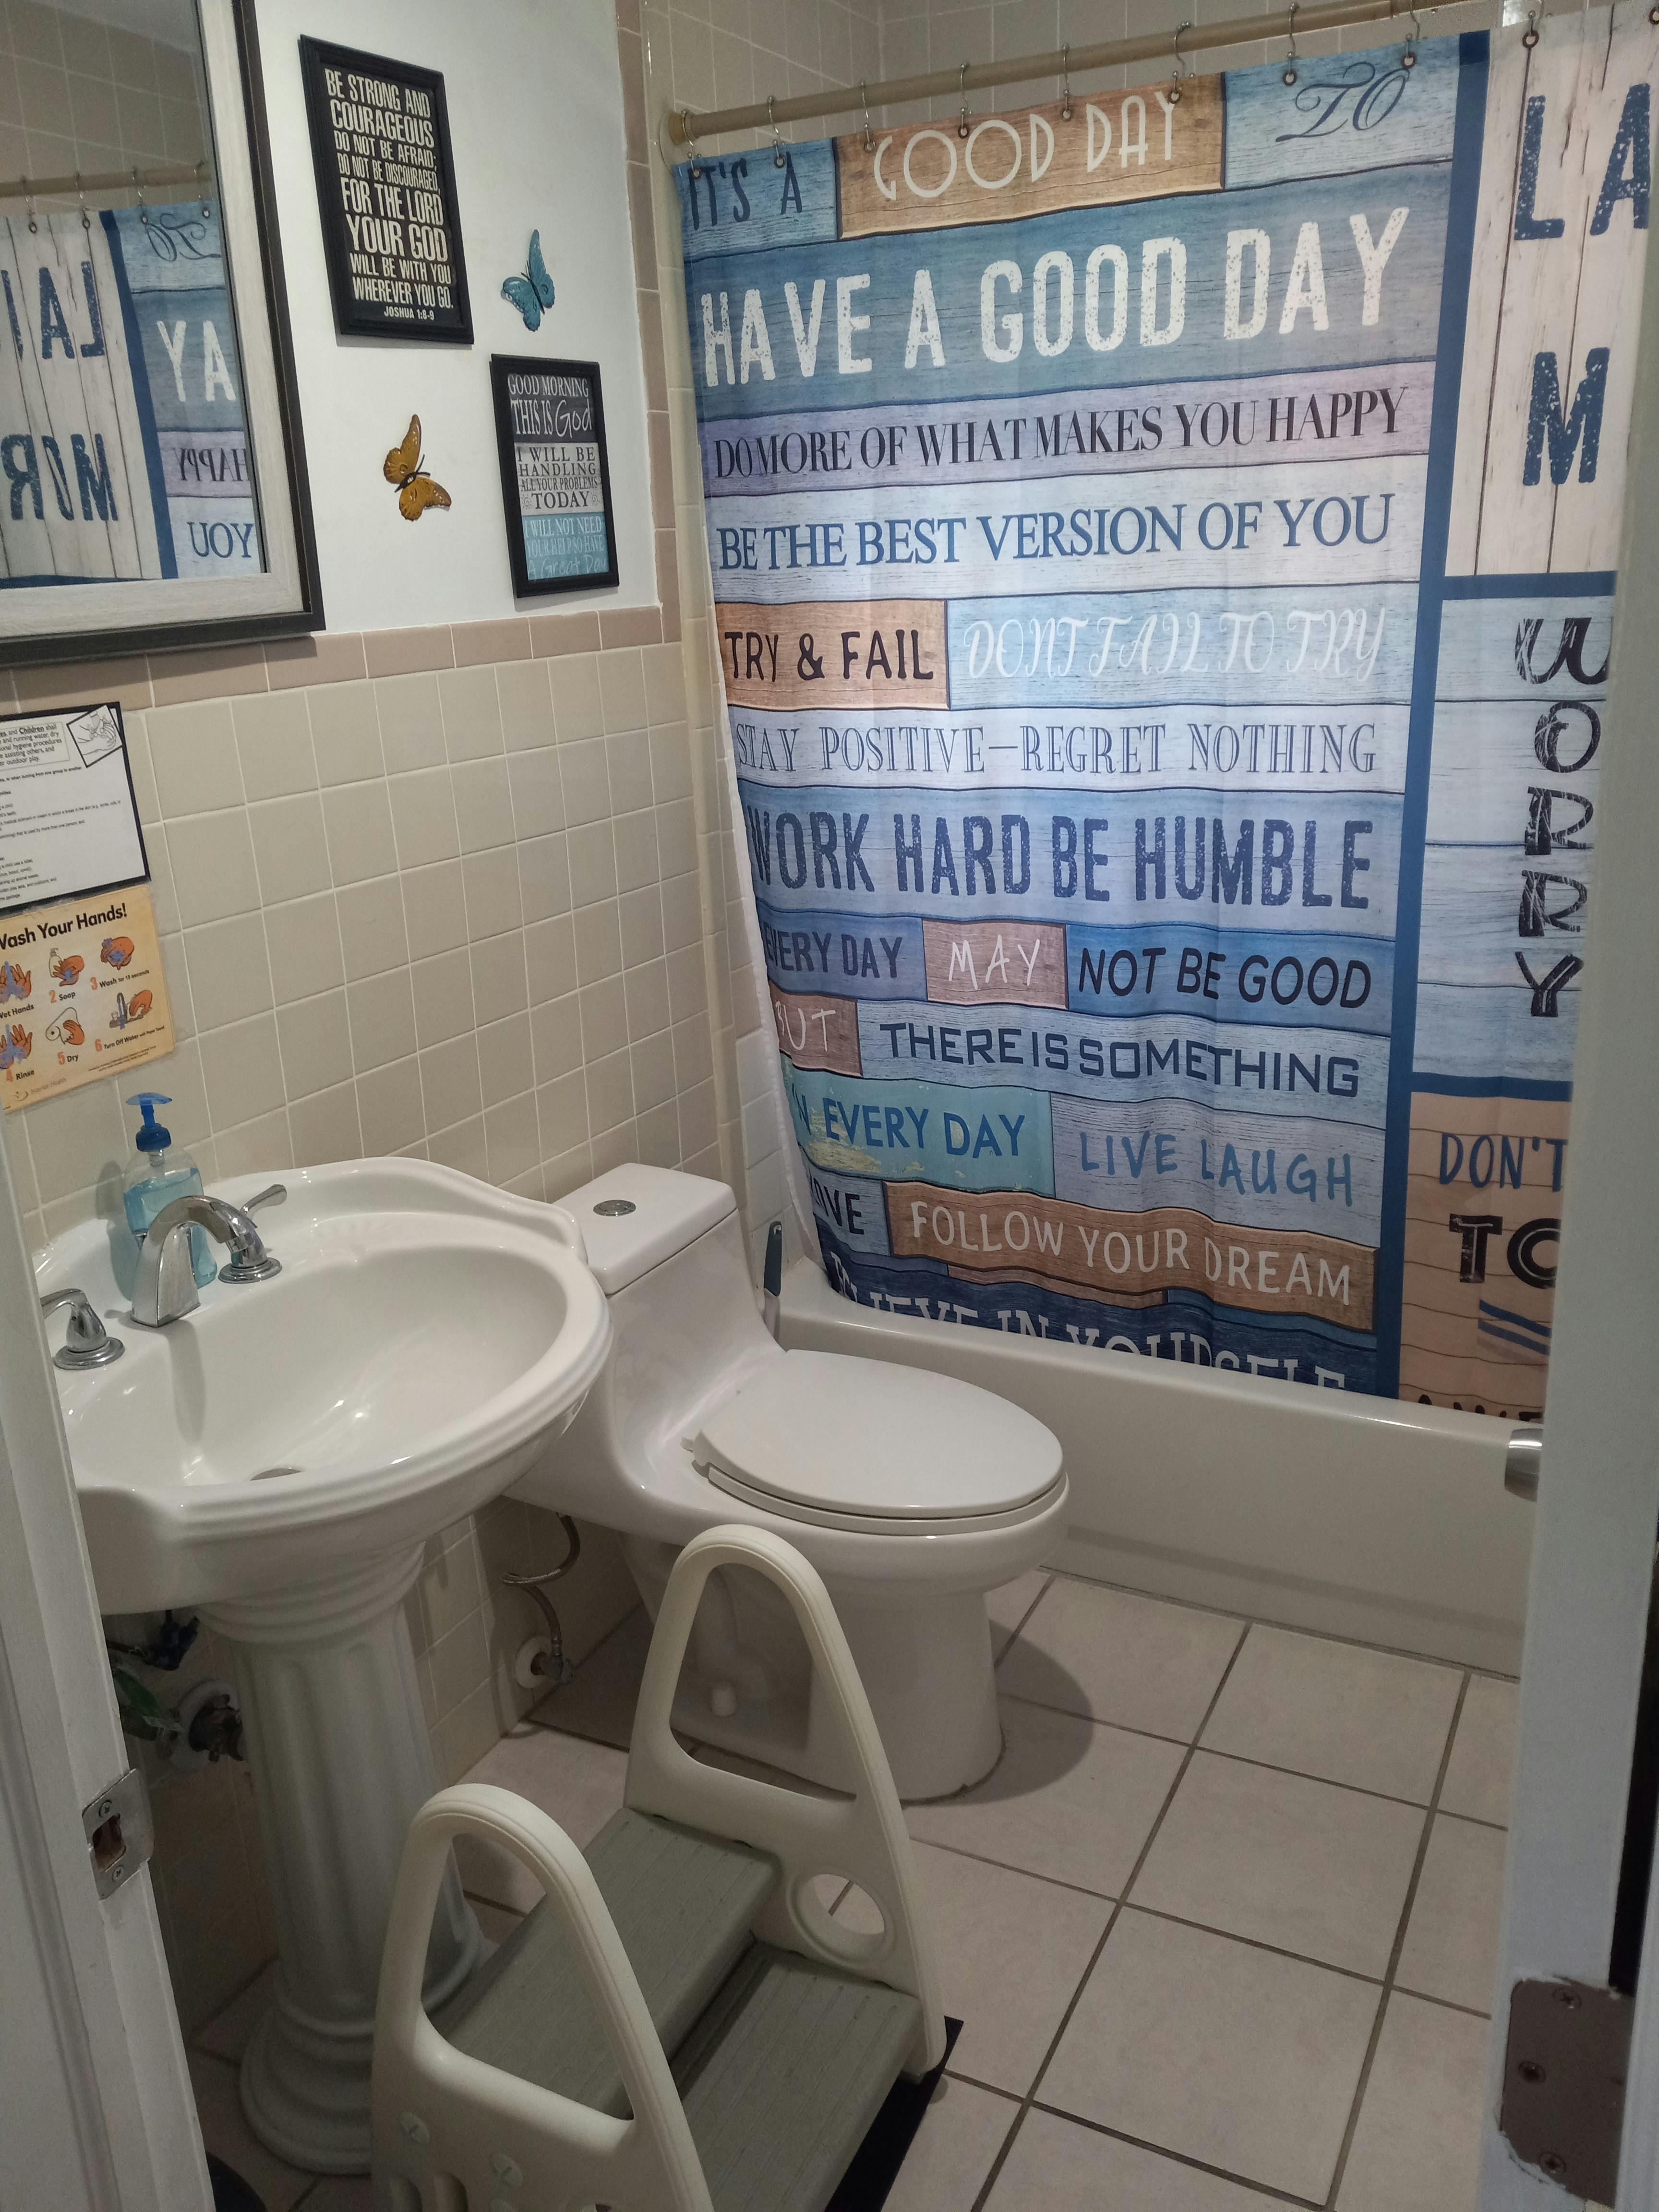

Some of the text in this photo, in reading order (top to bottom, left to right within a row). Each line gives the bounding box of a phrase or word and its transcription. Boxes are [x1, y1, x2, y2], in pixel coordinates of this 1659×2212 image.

[325, 68, 430, 118] BE STRONG AND
[330, 99, 434, 148] COURAGEOUS
[334, 130, 437, 172] DO NOT BE AFRAID;
[874, 90, 1175, 201] GOOD DAY
[337, 153, 440, 192] DO NOT BE DISCOURAGED,
[688, 152, 802, 230] IT'S A
[341, 177, 444, 226] FOR THE LORD
[346, 214, 447, 262] YOUR GOD
[349, 252, 451, 285] WILL BE WITH YOU
[352, 276, 453, 309] WHEREVER YOU GO.
[384, 305, 414, 319] JOSHUA
[701, 206, 1410, 387] HAVE A GOOD DAY
[507, 374, 589, 397] GOOD MORNING
[511, 398, 592, 438] THIS IS God
[713, 386, 1409, 478] DO MORE OF WHAT MAKES YOU HAPPY
[517, 446, 596, 462] I WILL BE
[518, 462, 596, 477] HANDLING
[521, 477, 598, 492] ALL YOUR PROBLEMS
[531, 491, 590, 509] TODAY
[524, 516, 602, 538] I WILL NOT NEED
[527, 535, 604, 557] YOUR HELP SO HAVE
[716, 493, 1395, 571] BE THE BEST VERSION OF YOU
[724, 628, 934, 683] TRY & FAIL
[1088, 612, 1209, 678] FAIL
[1218, 610, 1275, 673] TO
[1286, 607, 1386, 683] TRY
[19, 726, 45, 734] Children
[33, 739, 62, 747] procedures
[736, 723, 798, 772] STAY
[1188, 722, 1376, 773] NOTHING
[747, 805, 1373, 909] WORK HARD BE HUMBLE
[37, 919, 73, 938] Your
[76, 902, 128, 929] Hands!
[842, 934, 902, 979] DAY
[948, 935, 1040, 990] MAY
[49, 990, 76, 1004] 2 Soap
[90, 977, 98, 990] 3
[98, 977, 117, 989] Wash
[1079, 947, 1371, 1009] NOT BE GOOD
[12, 1004, 34, 1015] Hands
[58, 1052, 65, 1065] 5
[67, 1054, 79, 1064] Dry
[104, 1041, 115, 1050] Turn
[116, 1037, 124, 1046] Off
[124, 1034, 139, 1043] Water
[879, 1022, 1359, 1097] THERE IS SOMETHING
[15, 1069, 35, 1081] Rinse
[822, 1097, 929, 1149] EVERY
[943, 1111, 1025, 1159] DAY
[1080, 1131, 1353, 1207] LIVE LAUGH
[1440, 1132, 1568, 1192] DON'T
[911, 1201, 1350, 1306] FOLLOW YOUR DREAM
